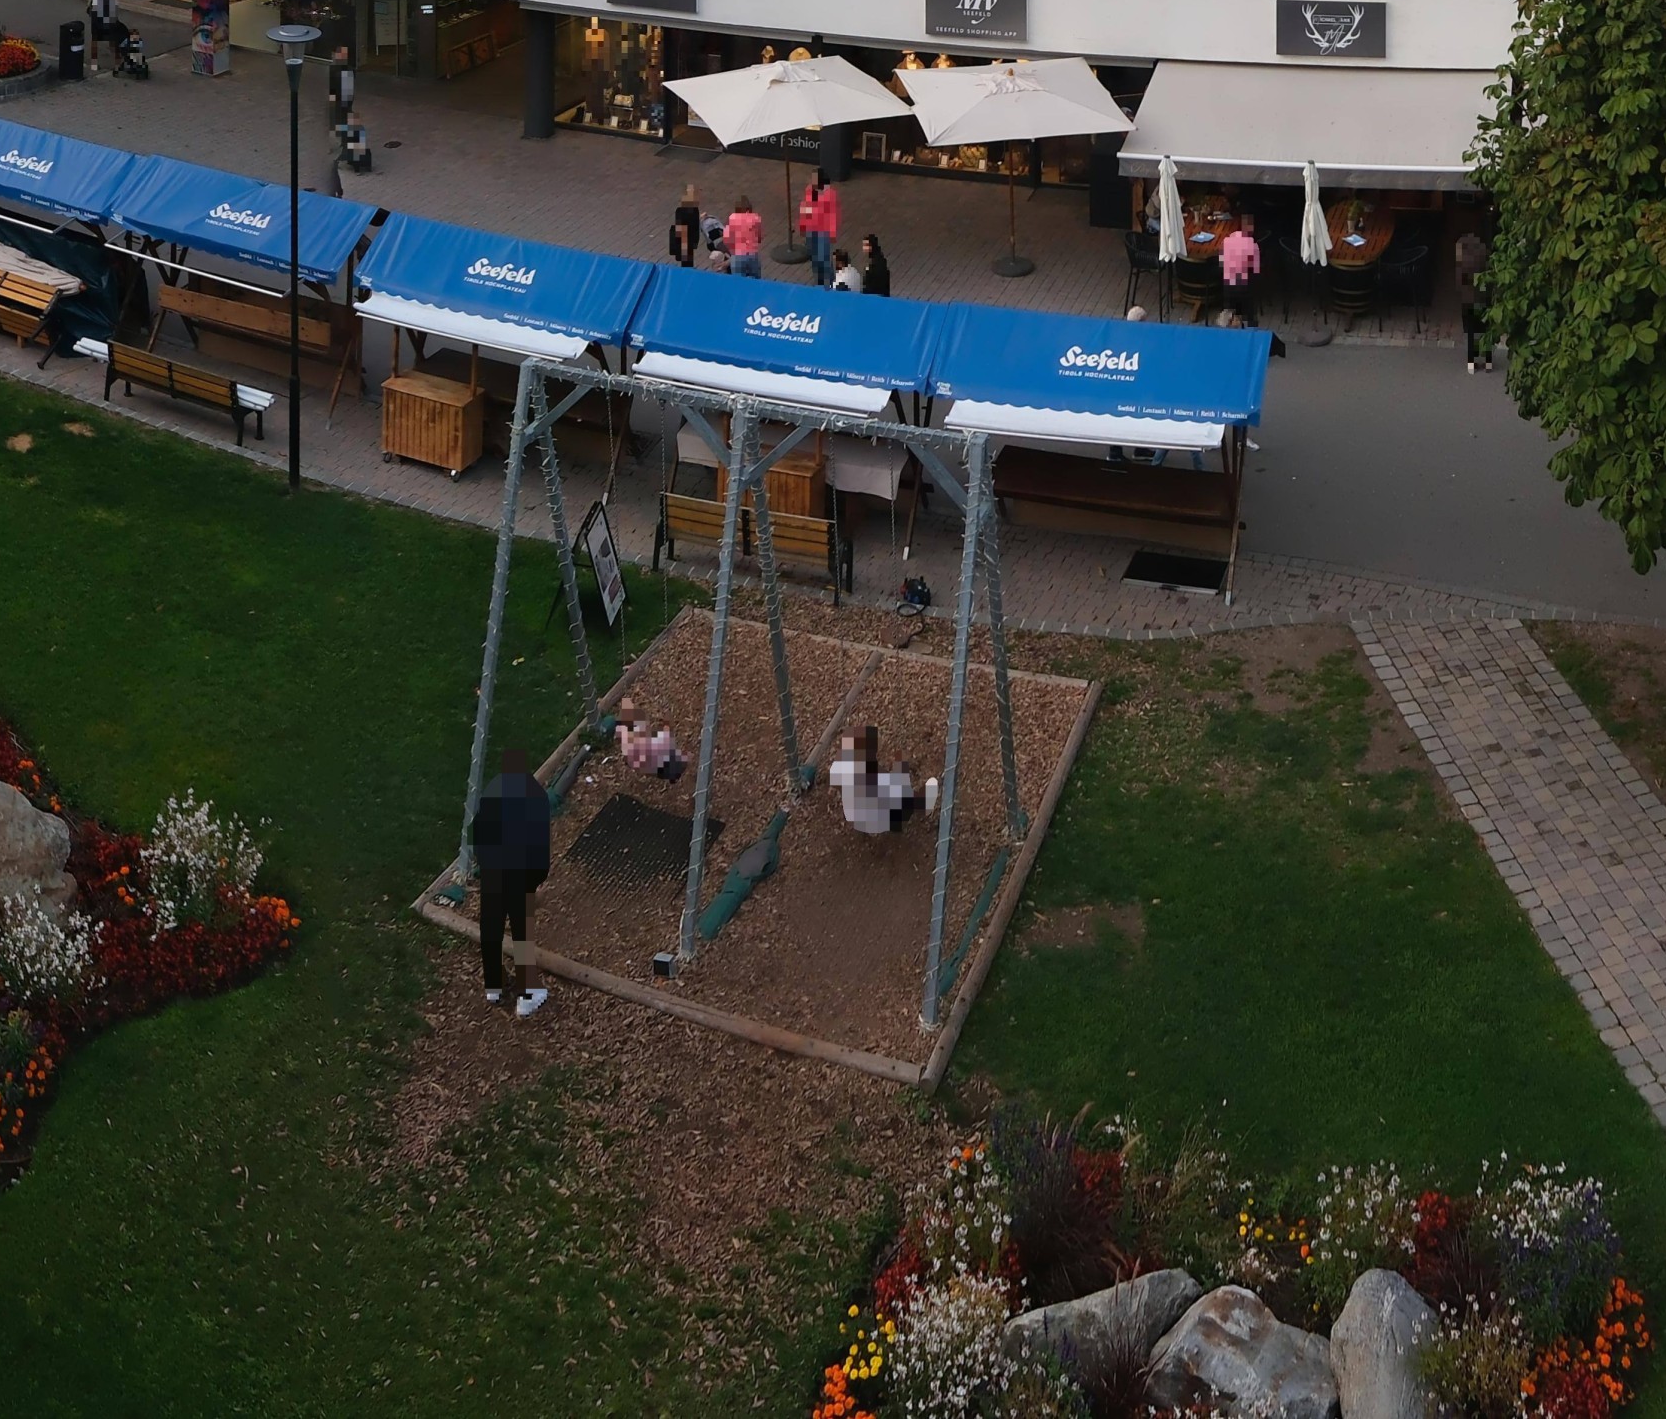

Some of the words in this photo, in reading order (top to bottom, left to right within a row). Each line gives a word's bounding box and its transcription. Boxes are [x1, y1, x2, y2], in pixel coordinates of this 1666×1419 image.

[963, 10, 992, 18] SEEFELD
[935, 26, 965, 34] SEEFELD
[966, 28, 1002, 37] SHOPPING
[0, 148, 55, 174] Seefeld
[208, 202, 273, 230] Seefeld
[466, 257, 537, 286] Seefeld
[746, 305, 823, 335] Seefeld
[1058, 344, 1140, 372] Seefeld
